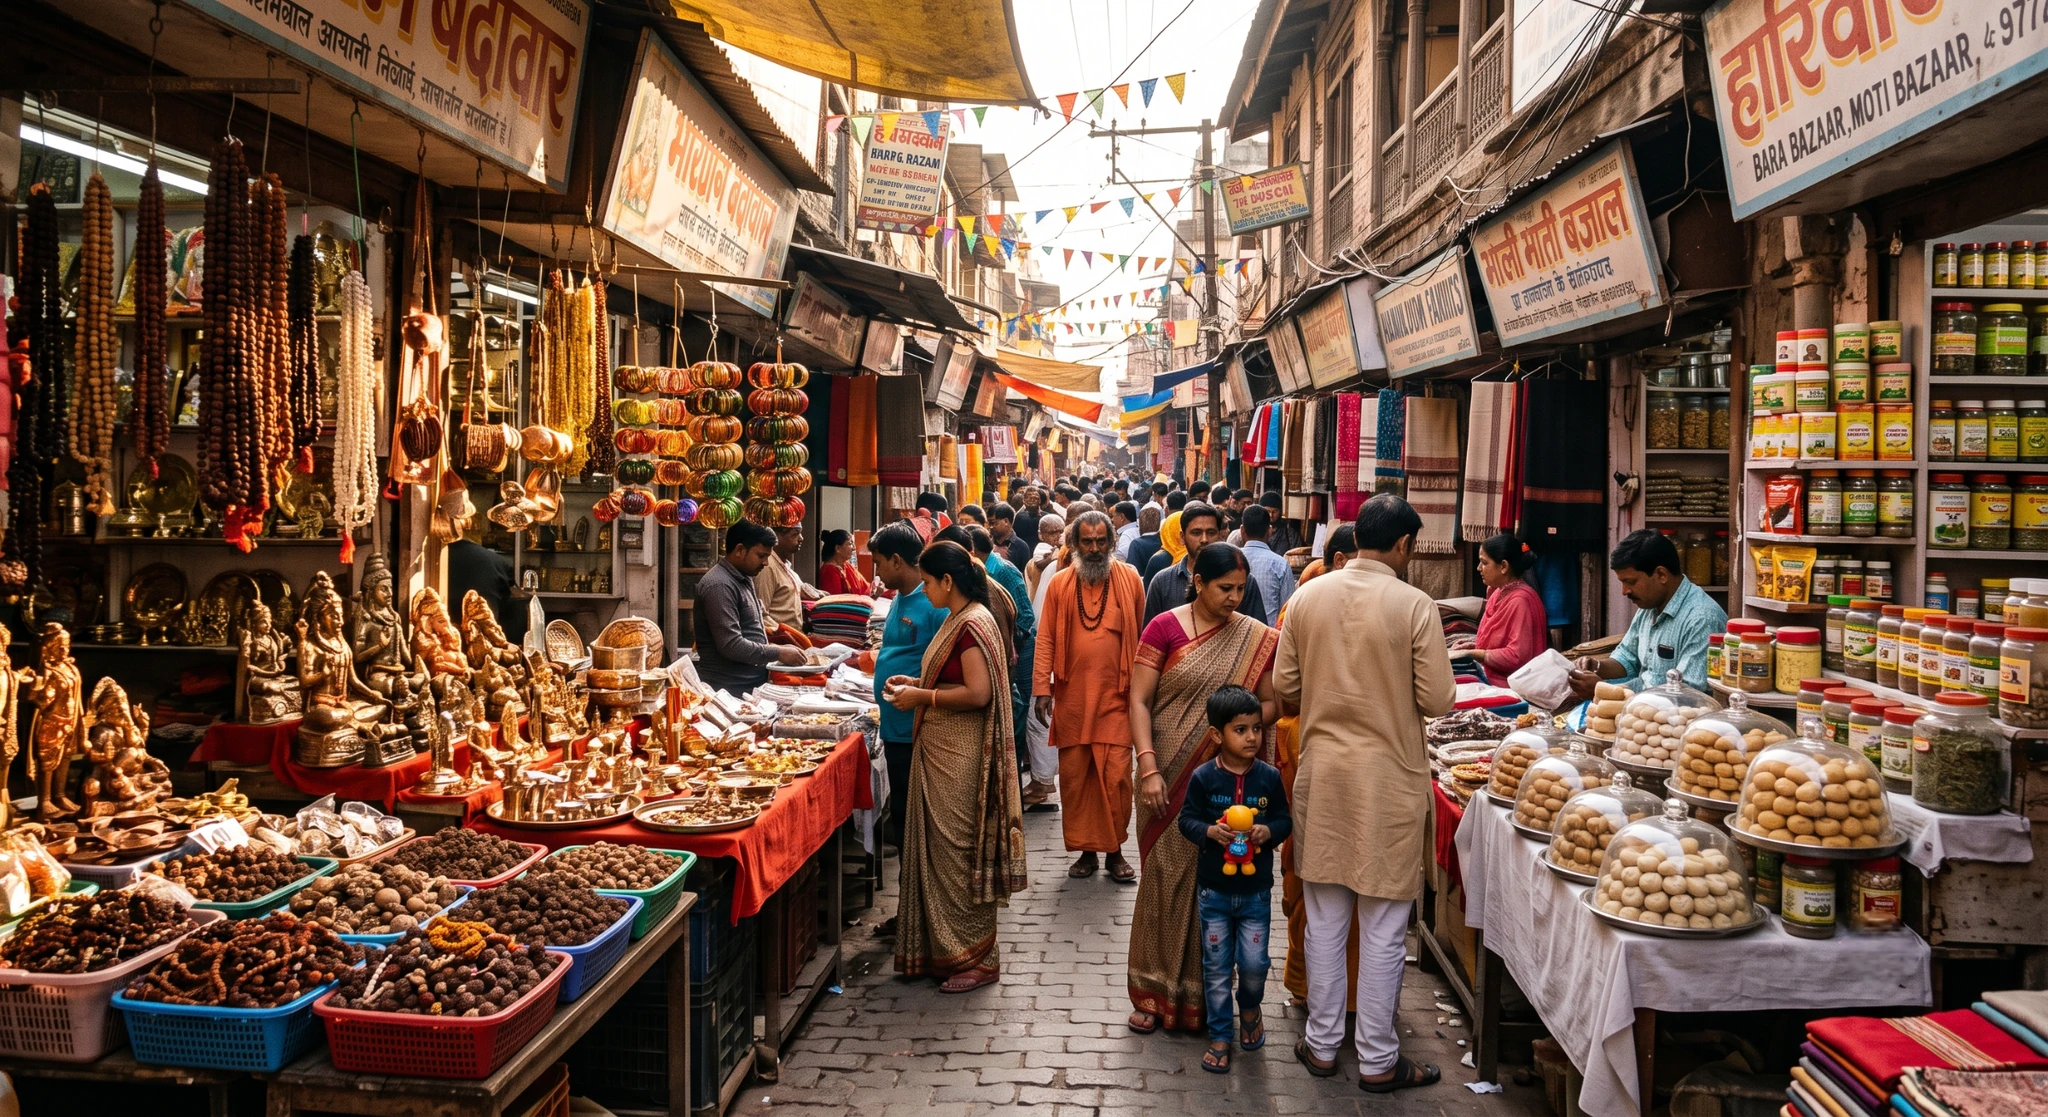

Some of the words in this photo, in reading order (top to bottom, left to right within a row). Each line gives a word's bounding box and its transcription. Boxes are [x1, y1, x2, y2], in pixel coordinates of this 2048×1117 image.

[1752, 138, 1788, 183] BARA
[1788, 105, 1852, 164] BAZAAR,
[1849, 78, 1891, 131] MOTI
[905, 153, 941, 170] RAZAM
